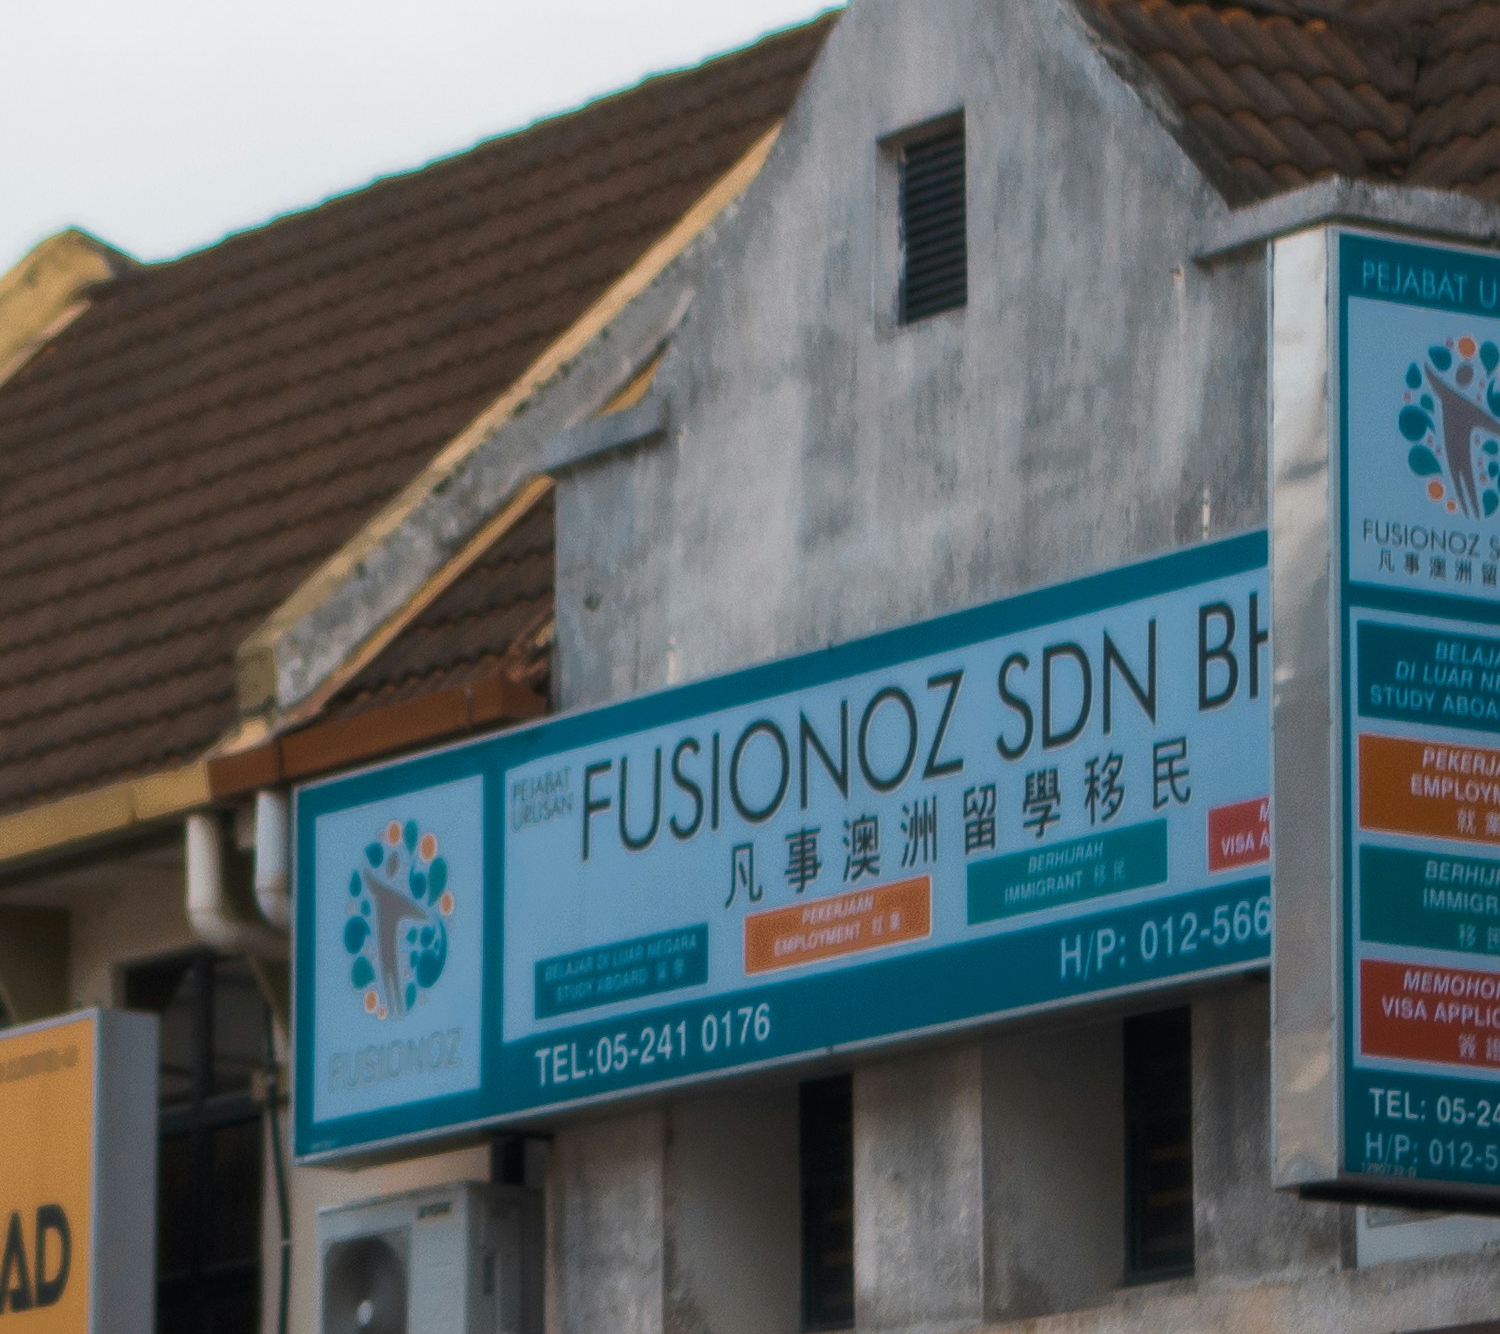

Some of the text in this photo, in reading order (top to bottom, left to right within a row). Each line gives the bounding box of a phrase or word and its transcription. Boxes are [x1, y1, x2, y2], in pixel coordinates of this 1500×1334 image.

[1362, 259, 1468, 305] PEJABAT
[1363, 517, 1480, 560] FUSIONOZ
[1396, 660, 1416, 681] DI
[1423, 664, 1473, 689] LUAR
[1370, 684, 1435, 711] STUDY
[582, 669, 965, 861] FUSIONOZ
[996, 618, 1156, 761] SDN
[725, 736, 1191, 909] 凡事澳洲留學移民
[1027, 841, 1104, 873] BERHIJRAH
[1221, 831, 1255, 857] VISA
[1004, 870, 1083, 905] IMMIGRANT
[774, 921, 862, 957] EMPLOYMENT
[1060, 895, 1271, 981] H/P: 012-566
[1381, 995, 1428, 1020] VISA
[701, 1002, 771, 1054] 0176
[328, 1026, 463, 1093] FUSIONOZ
[1368, 1087, 1425, 1122] TEL:
[1365, 1131, 1418, 1165] H/P:
